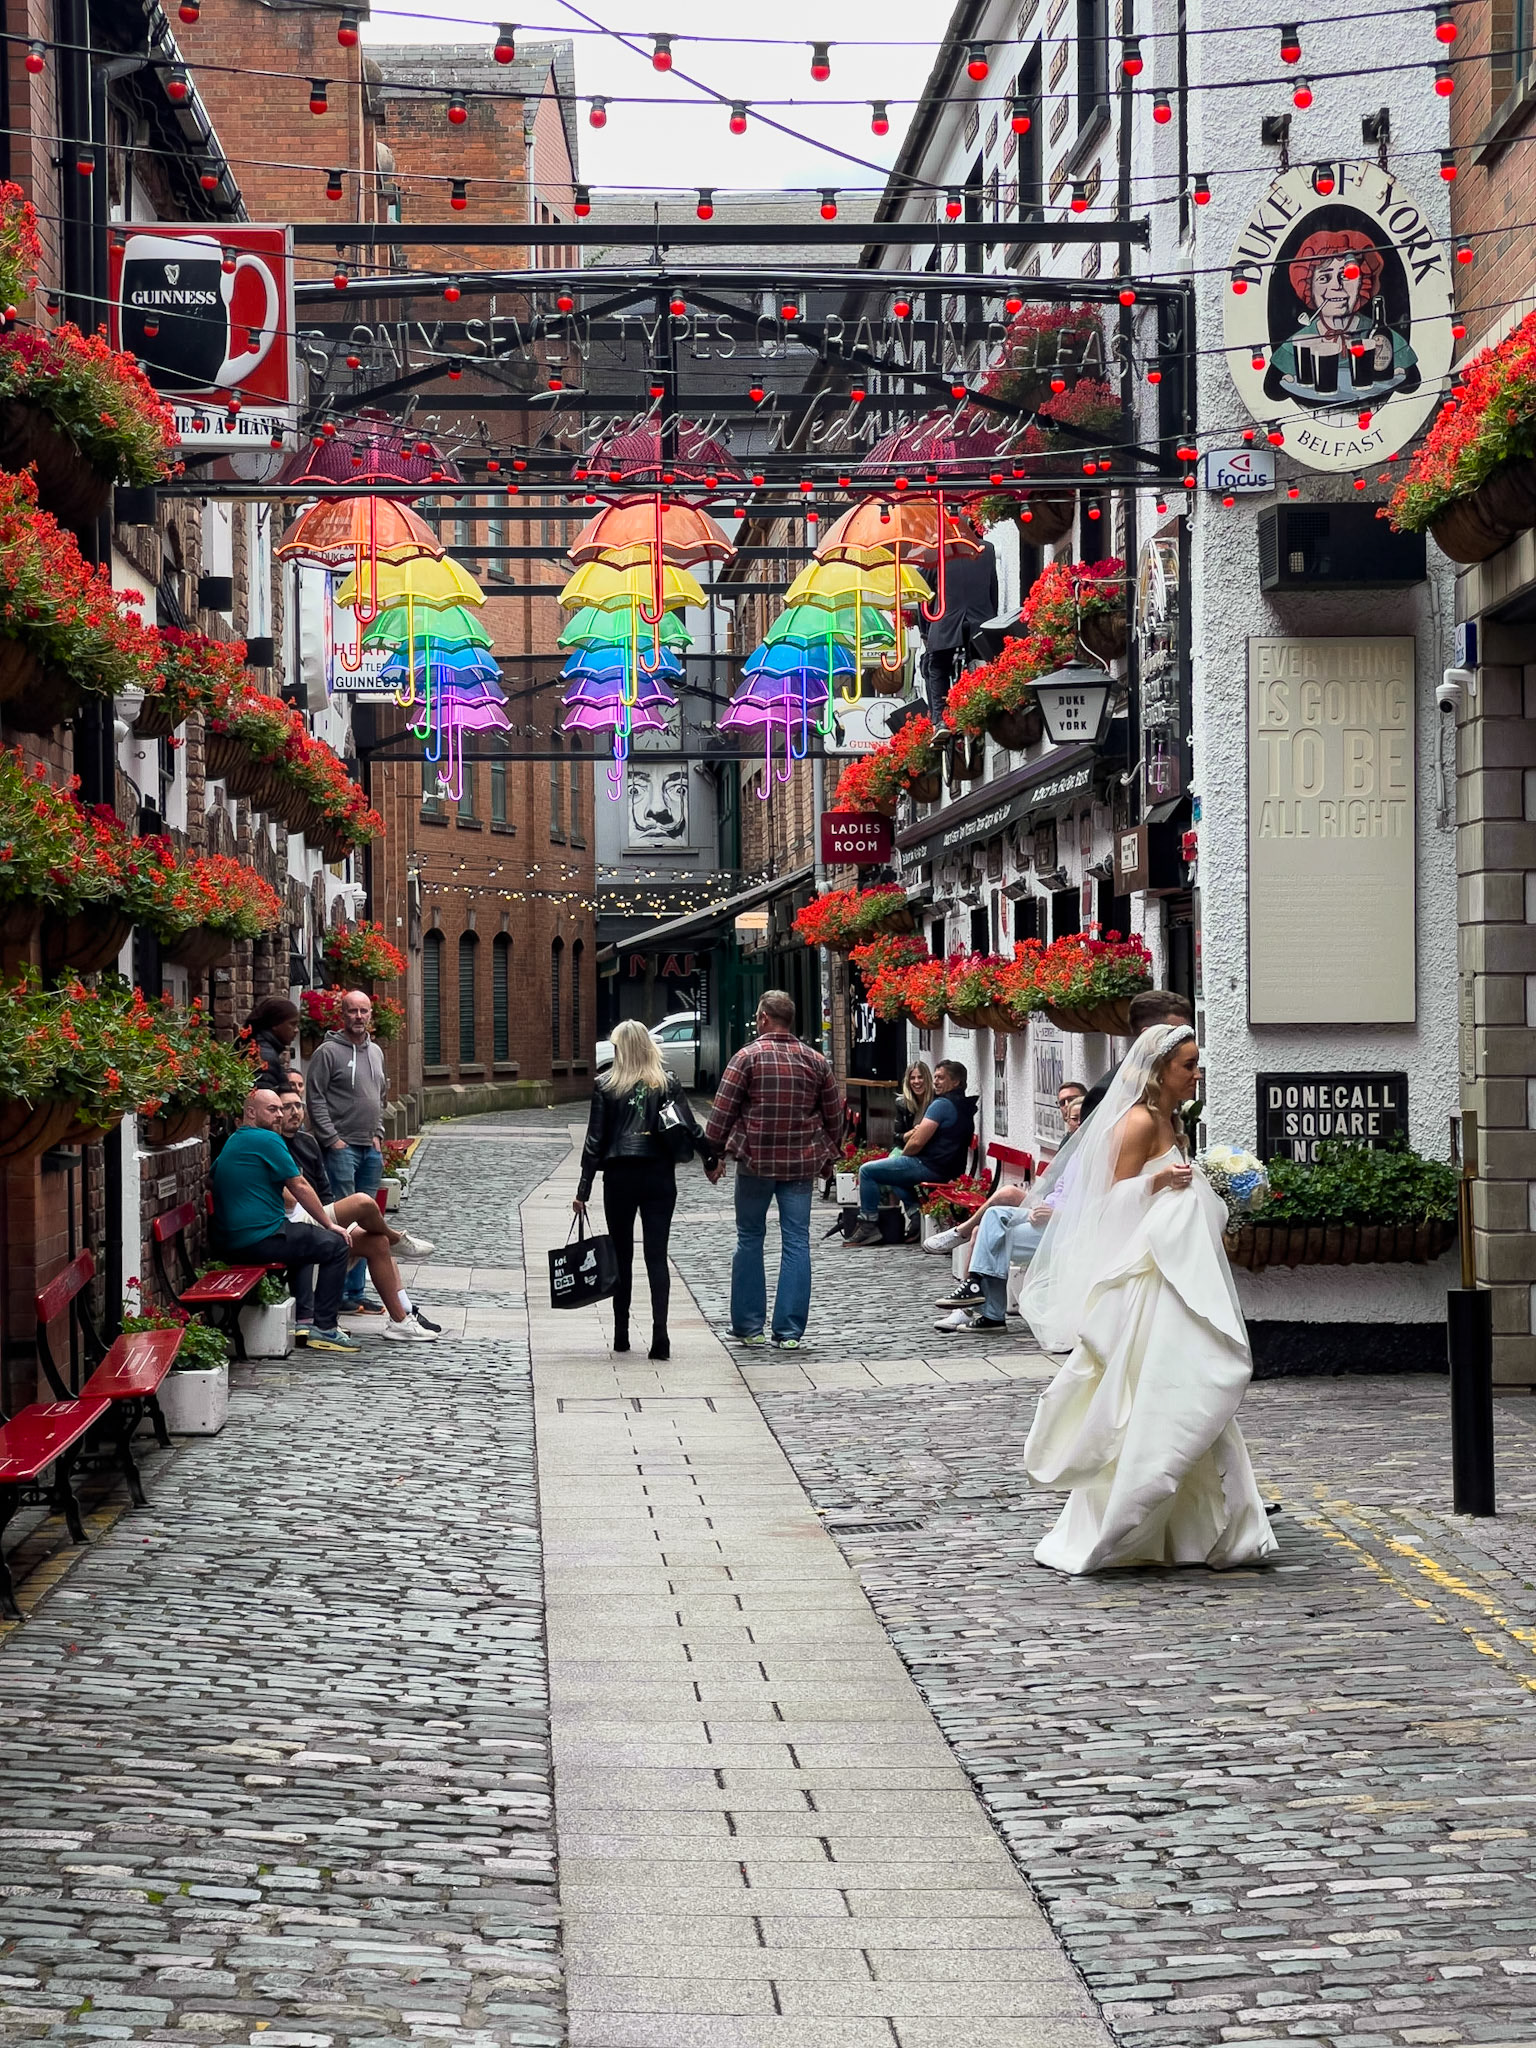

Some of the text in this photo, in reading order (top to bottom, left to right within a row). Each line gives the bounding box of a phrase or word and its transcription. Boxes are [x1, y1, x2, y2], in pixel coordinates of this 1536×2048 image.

[1232, 163, 1446, 287] DUKE OF YORK
[131, 290, 217, 305] GUINNESS
[613, 313, 737, 361] TYPES
[755, 387, 1036, 457] Wednesday
[1297, 428, 1385, 458] BELFAST
[1217, 468, 1267, 488] focus
[1258, 645, 1407, 678] EVERYTHING
[335, 676, 399, 688] GUINNESS
[1058, 695, 1086, 706] DUKE
[1066, 708, 1079, 718] OF
[1258, 679, 1407, 726] IS GOING
[1058, 721, 1087, 731] YORK
[1258, 728, 1407, 798] TO BE
[831, 822, 881, 835] LADIES
[1258, 799, 1407, 839] ALL RIGHT
[834, 840, 878, 852] ROOM
[1286, 1112, 1380, 1137] SQUARE
